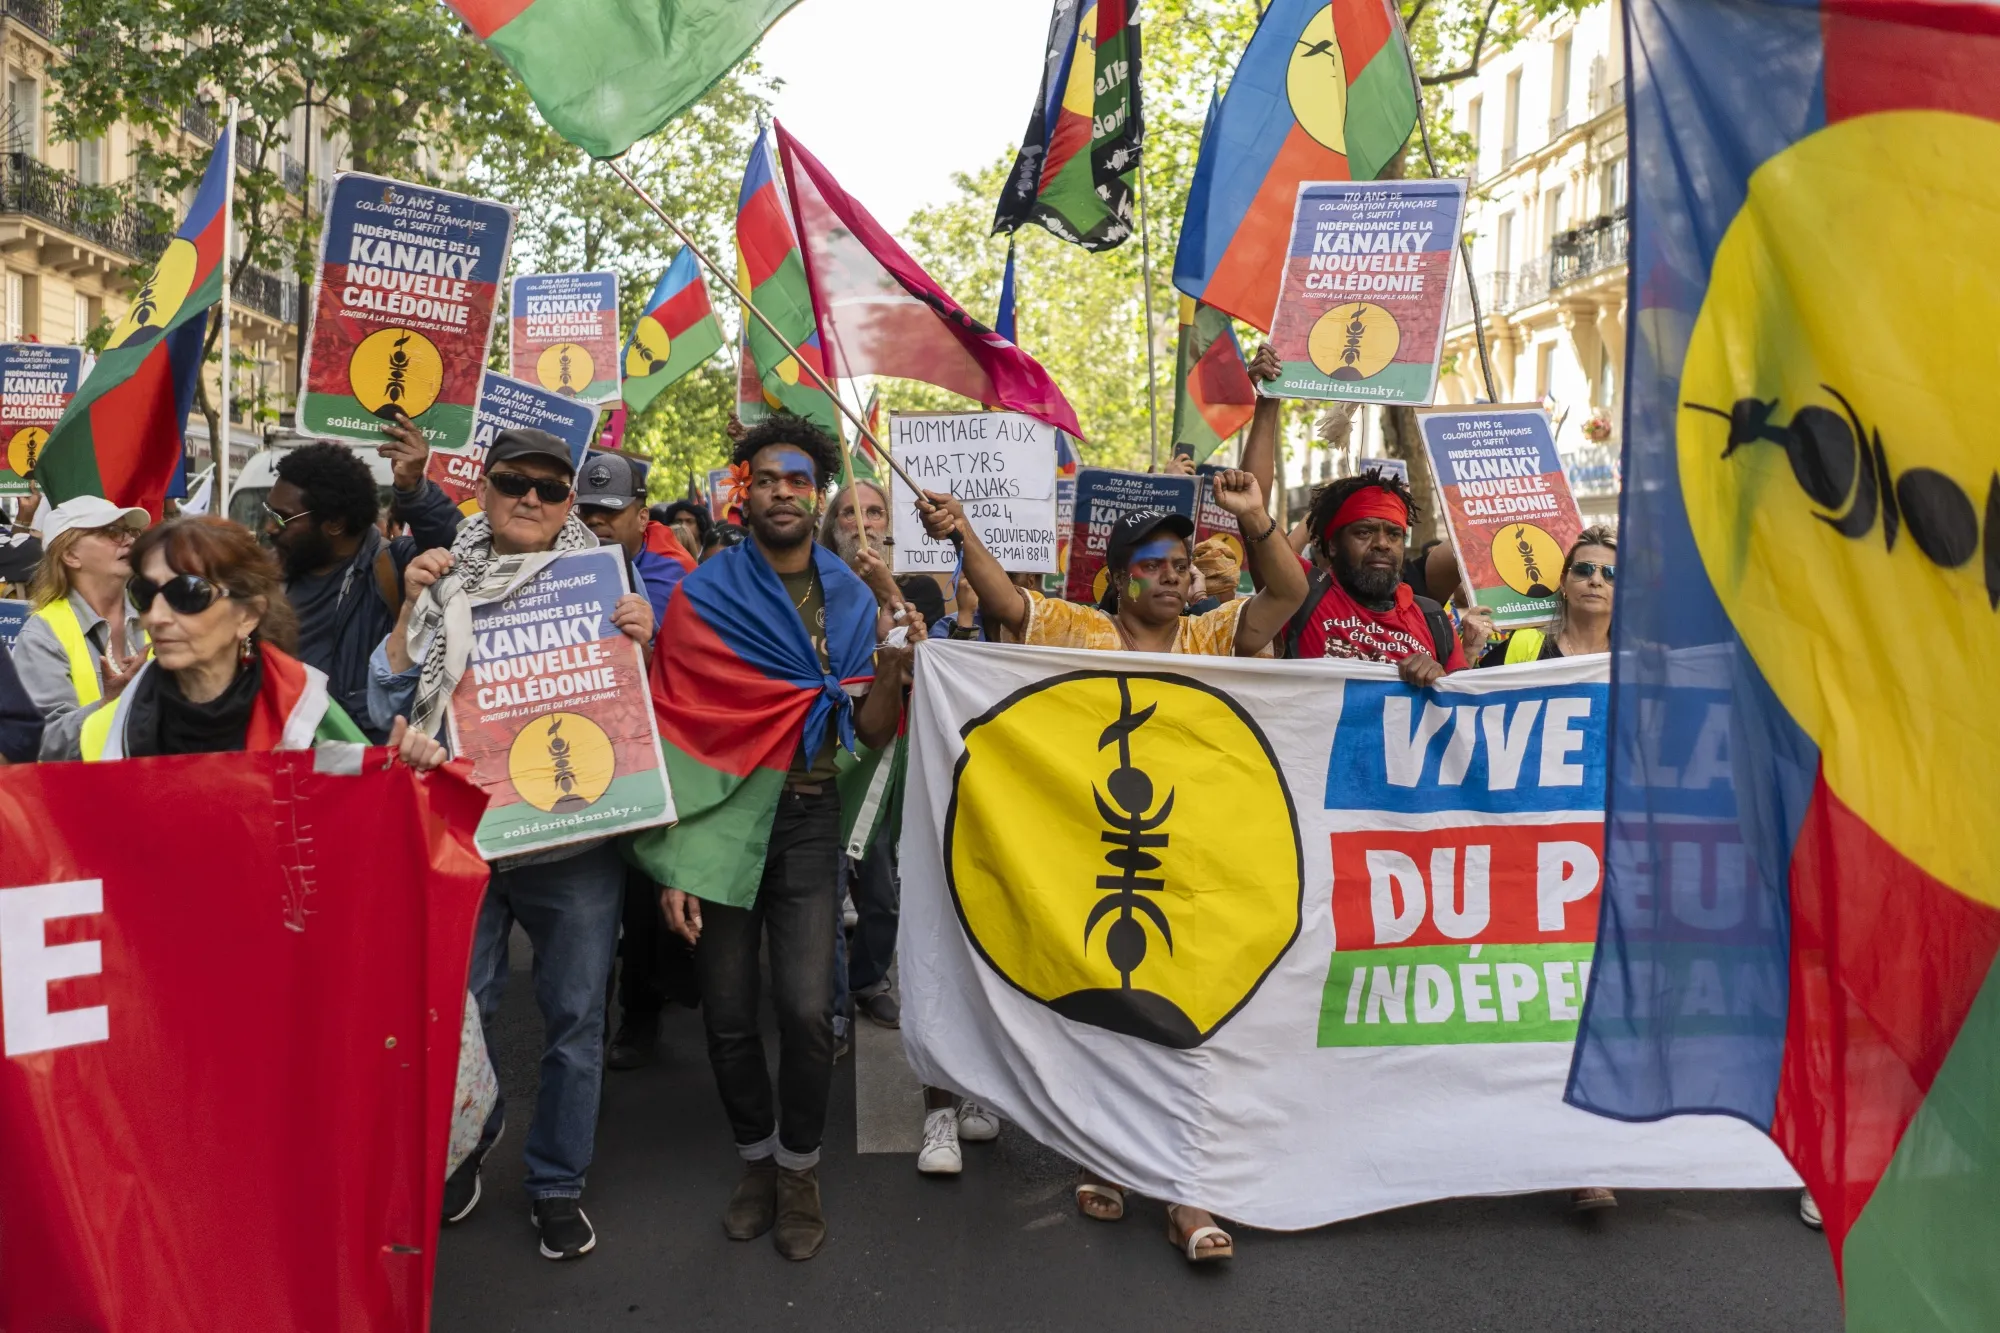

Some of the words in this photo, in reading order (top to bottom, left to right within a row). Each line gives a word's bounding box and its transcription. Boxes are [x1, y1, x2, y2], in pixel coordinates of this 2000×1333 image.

[407, 197, 434, 210] ANS
[437, 204, 450, 213] DE
[1319, 202, 1384, 211] COLONISATION
[1387, 200, 1438, 209] FRANÇAISE
[1344, 193, 1360, 202] 170
[1364, 192, 1387, 202] ANS
[1390, 192, 1402, 200] DE
[356, 201, 431, 220] COLONISATION
[434, 214, 487, 231] FRANÇAISE
[1352, 212, 1363, 220] ÇA
[1366, 211, 1396, 219] SUFFIT
[394, 219, 407, 228] ÇA
[410, 221, 442, 234] SUFFIT
[1316, 221, 1400, 231] INDÉPENDANCE
[1403, 222, 1417, 230] DE
[1420, 222, 1433, 230] LA
[353, 223, 446, 250] INDÉPENDANCE
[449, 241, 465, 253] DE
[466, 245, 480, 256] LA
[1313, 232, 1432, 253] KANAKY
[350, 236, 478, 280] KANAKY
[1309, 255, 1427, 272] NOUVELLE-
[346, 263, 472, 301] NOUVELLE-
[1306, 272, 1424, 291] CALÉDONIE
[343, 286, 469, 325] CALÉDONIE
[528, 299, 601, 313] KANAKY
[340, 310, 368, 319] SOUTIEN
[416, 322, 440, 330] PEUPLE
[442, 326, 463, 334] KANAK
[527, 313, 602, 325] NOUVELLE-
[527, 324, 602, 336] CALÉDONIE
[5, 370, 50, 378] INDÉPENDANCE
[4, 378, 67, 393] KANAKY
[1284, 379, 1404, 398] solidaritekanaky.fr
[3, 393, 65, 406] NOUVELLE-
[495, 385, 510, 396] 170
[512, 391, 534, 404] ANS
[535, 399, 547, 408] DE
[481, 392, 530, 412] LONISATION
[531, 408, 574, 426] FRANÇAISE
[499, 407, 509, 416] ÇA
[512, 411, 537, 424] SUFFIT
[900, 418, 988, 444] HOMMAGE
[996, 419, 1036, 443] AUX
[1442, 430, 1493, 440] COLONISATION
[1495, 427, 1532, 437] FRANÇAISE
[1457, 422, 1471, 431] 170
[1474, 421, 1491, 430] ANS
[1483, 438, 1505, 446] SUFFIT
[1448, 447, 1514, 459] INDÉPENDANCE
[906, 452, 1004, 477] MARTYRS
[1452, 456, 1541, 480] KANAKY
[951, 478, 1020, 500] KANAKS
[1092, 484, 1141, 494] COLONISATION
[1111, 478, 1123, 486] 170
[1125, 480, 1143, 488] ANS
[1457, 477, 1550, 498] NOUVELLE-
[972, 504, 1012, 523] 2024
[1464, 494, 1558, 516] CALÉDONIE
[984, 528, 1055, 544] SOUVIENDRA
[904, 550, 938, 564] TOUT
[540, 570, 553, 579] DE
[540, 574, 596, 592] FRANÇAISE
[502, 602, 516, 612] ÇA
[520, 594, 552, 608] SUFFIT
[473, 605, 565, 631] NDÉPENDANCE
[566, 604, 583, 616] DE
[586, 601, 602, 612] LA
[473, 614, 602, 661] KANAKY
[472, 644, 611, 685] NOUVELLE-
[478, 666, 616, 710] CALÉDONIE
[481, 711, 509, 723] SOUTIEN
[531, 702, 552, 714] LUTTE
[564, 696, 589, 708] PEUPLE
[592, 690, 616, 700] KANAK
[1383, 695, 1591, 790] VIVE
[1366, 845, 1491, 945] DU
[0, 879, 109, 1058] E
